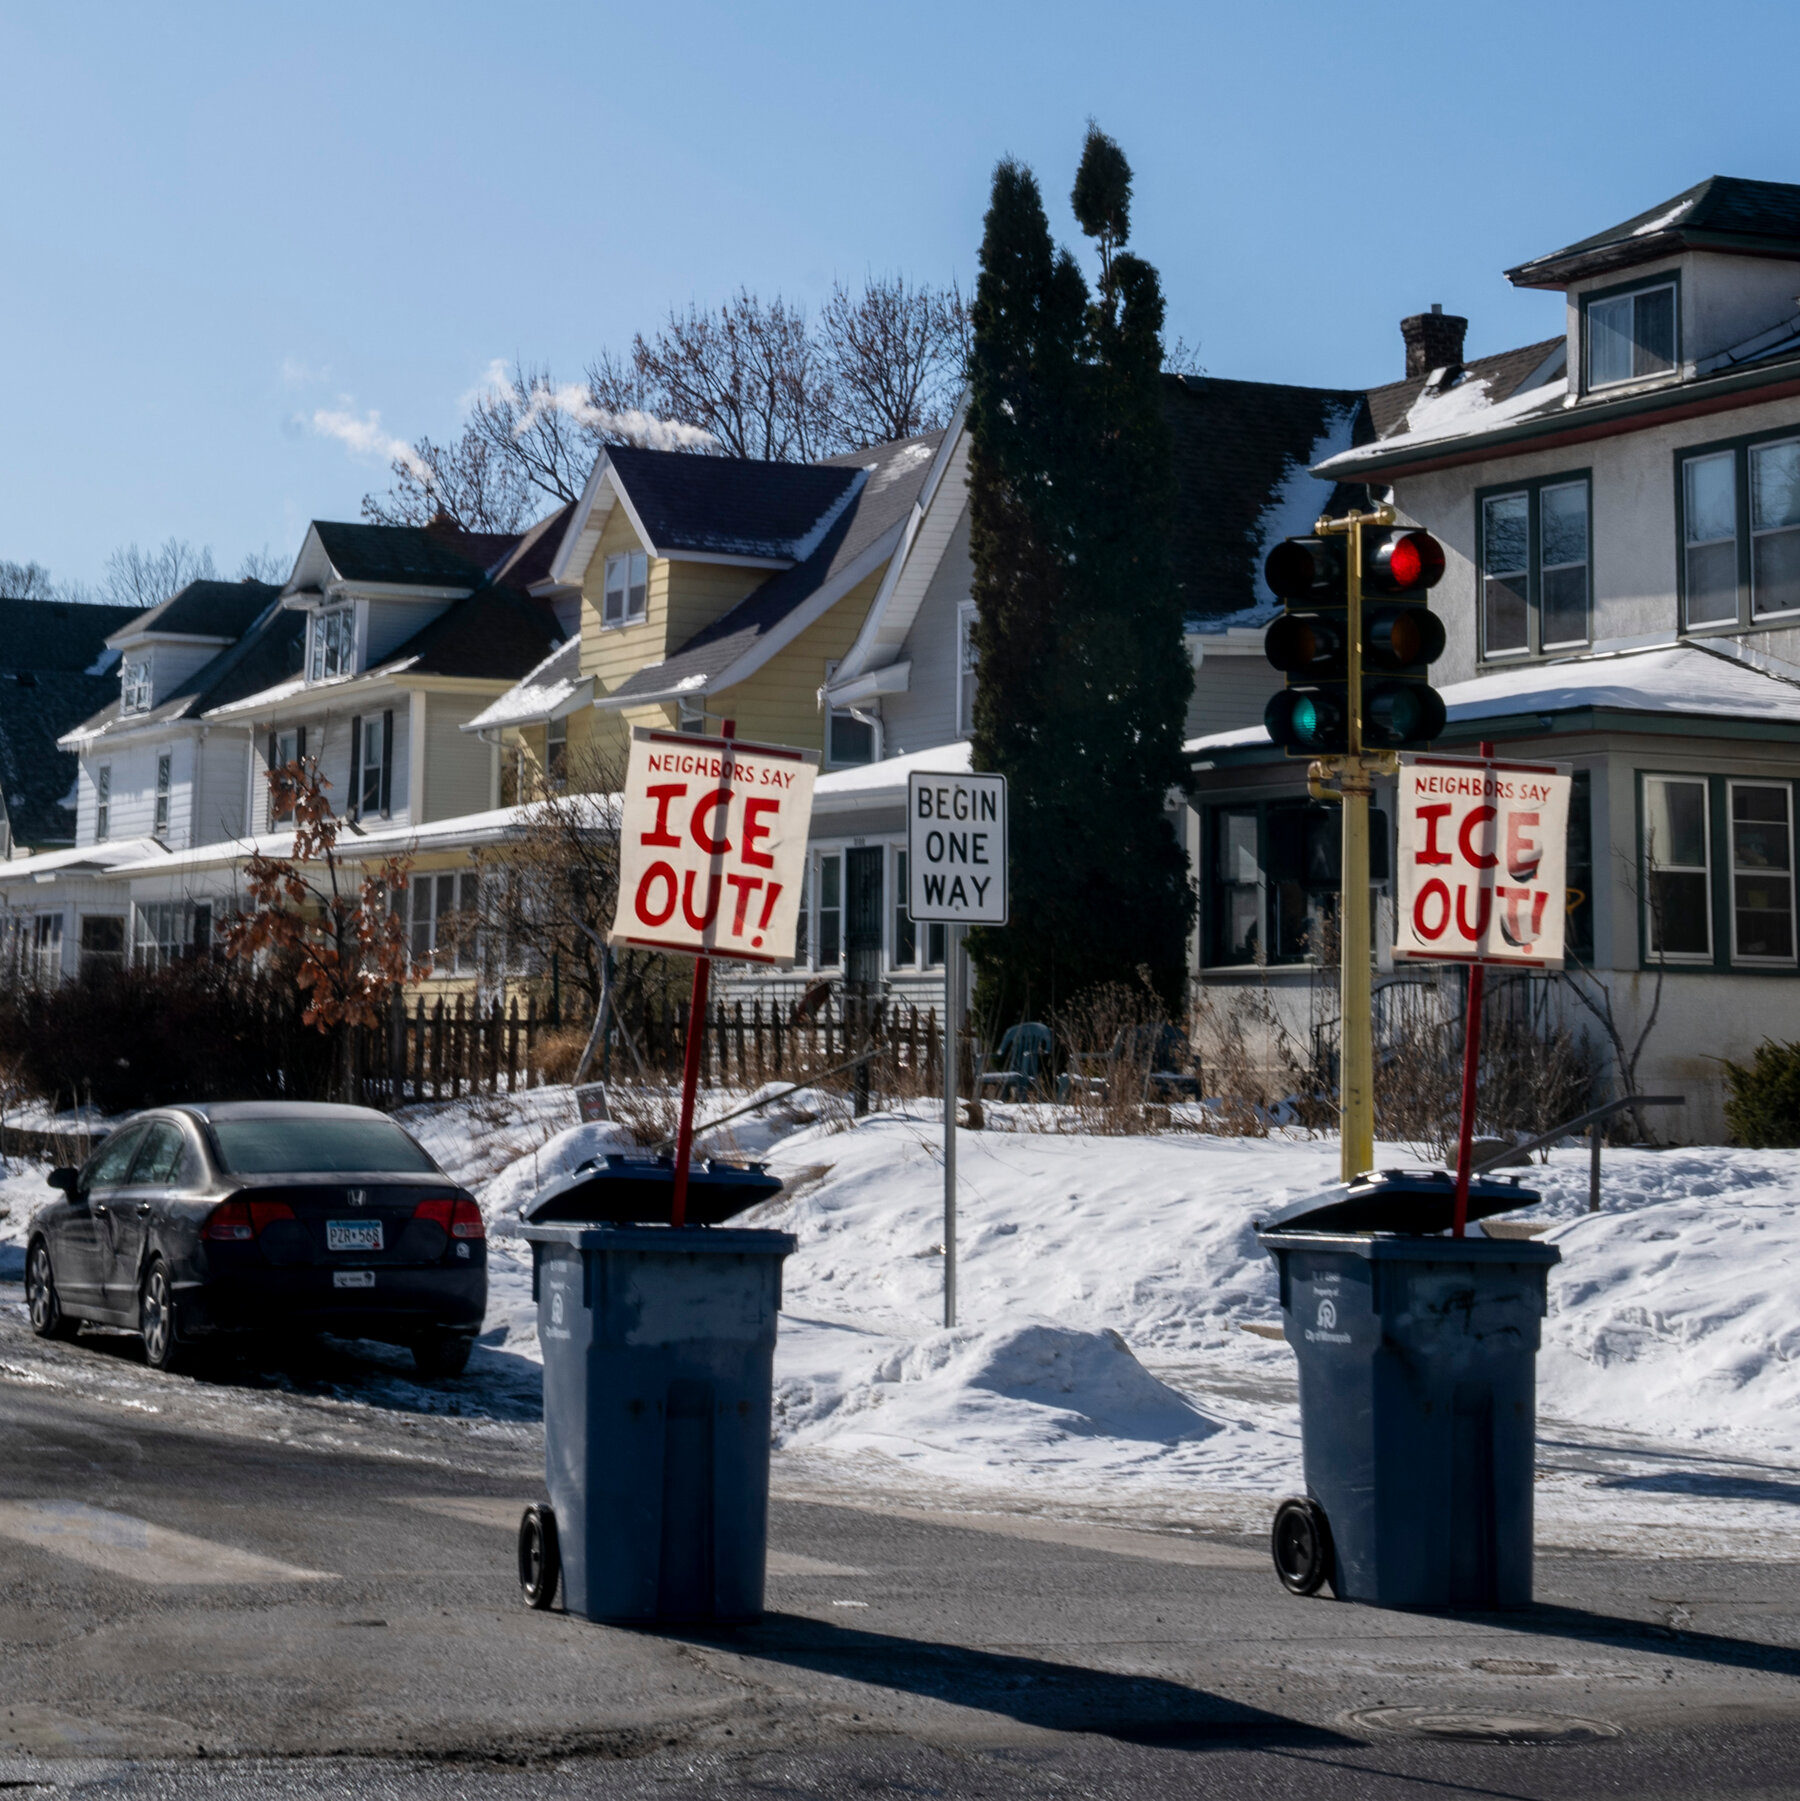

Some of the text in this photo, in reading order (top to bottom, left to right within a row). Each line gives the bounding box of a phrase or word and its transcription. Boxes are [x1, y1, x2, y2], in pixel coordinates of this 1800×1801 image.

[648, 754, 796, 789] NEIGHBORS SAY
[918, 787, 996, 822] BEGIN
[1415, 776, 1552, 803] NEIGHBORS SAY
[640, 783, 781, 870] ICE
[1415, 802, 1540, 880] ICE
[926, 831, 989, 864] ONE
[634, 860, 784, 948] OUT!
[923, 874, 991, 908] WAY
[1413, 877, 1550, 954] OUT!
[330, 1228, 351, 1243] PZR
